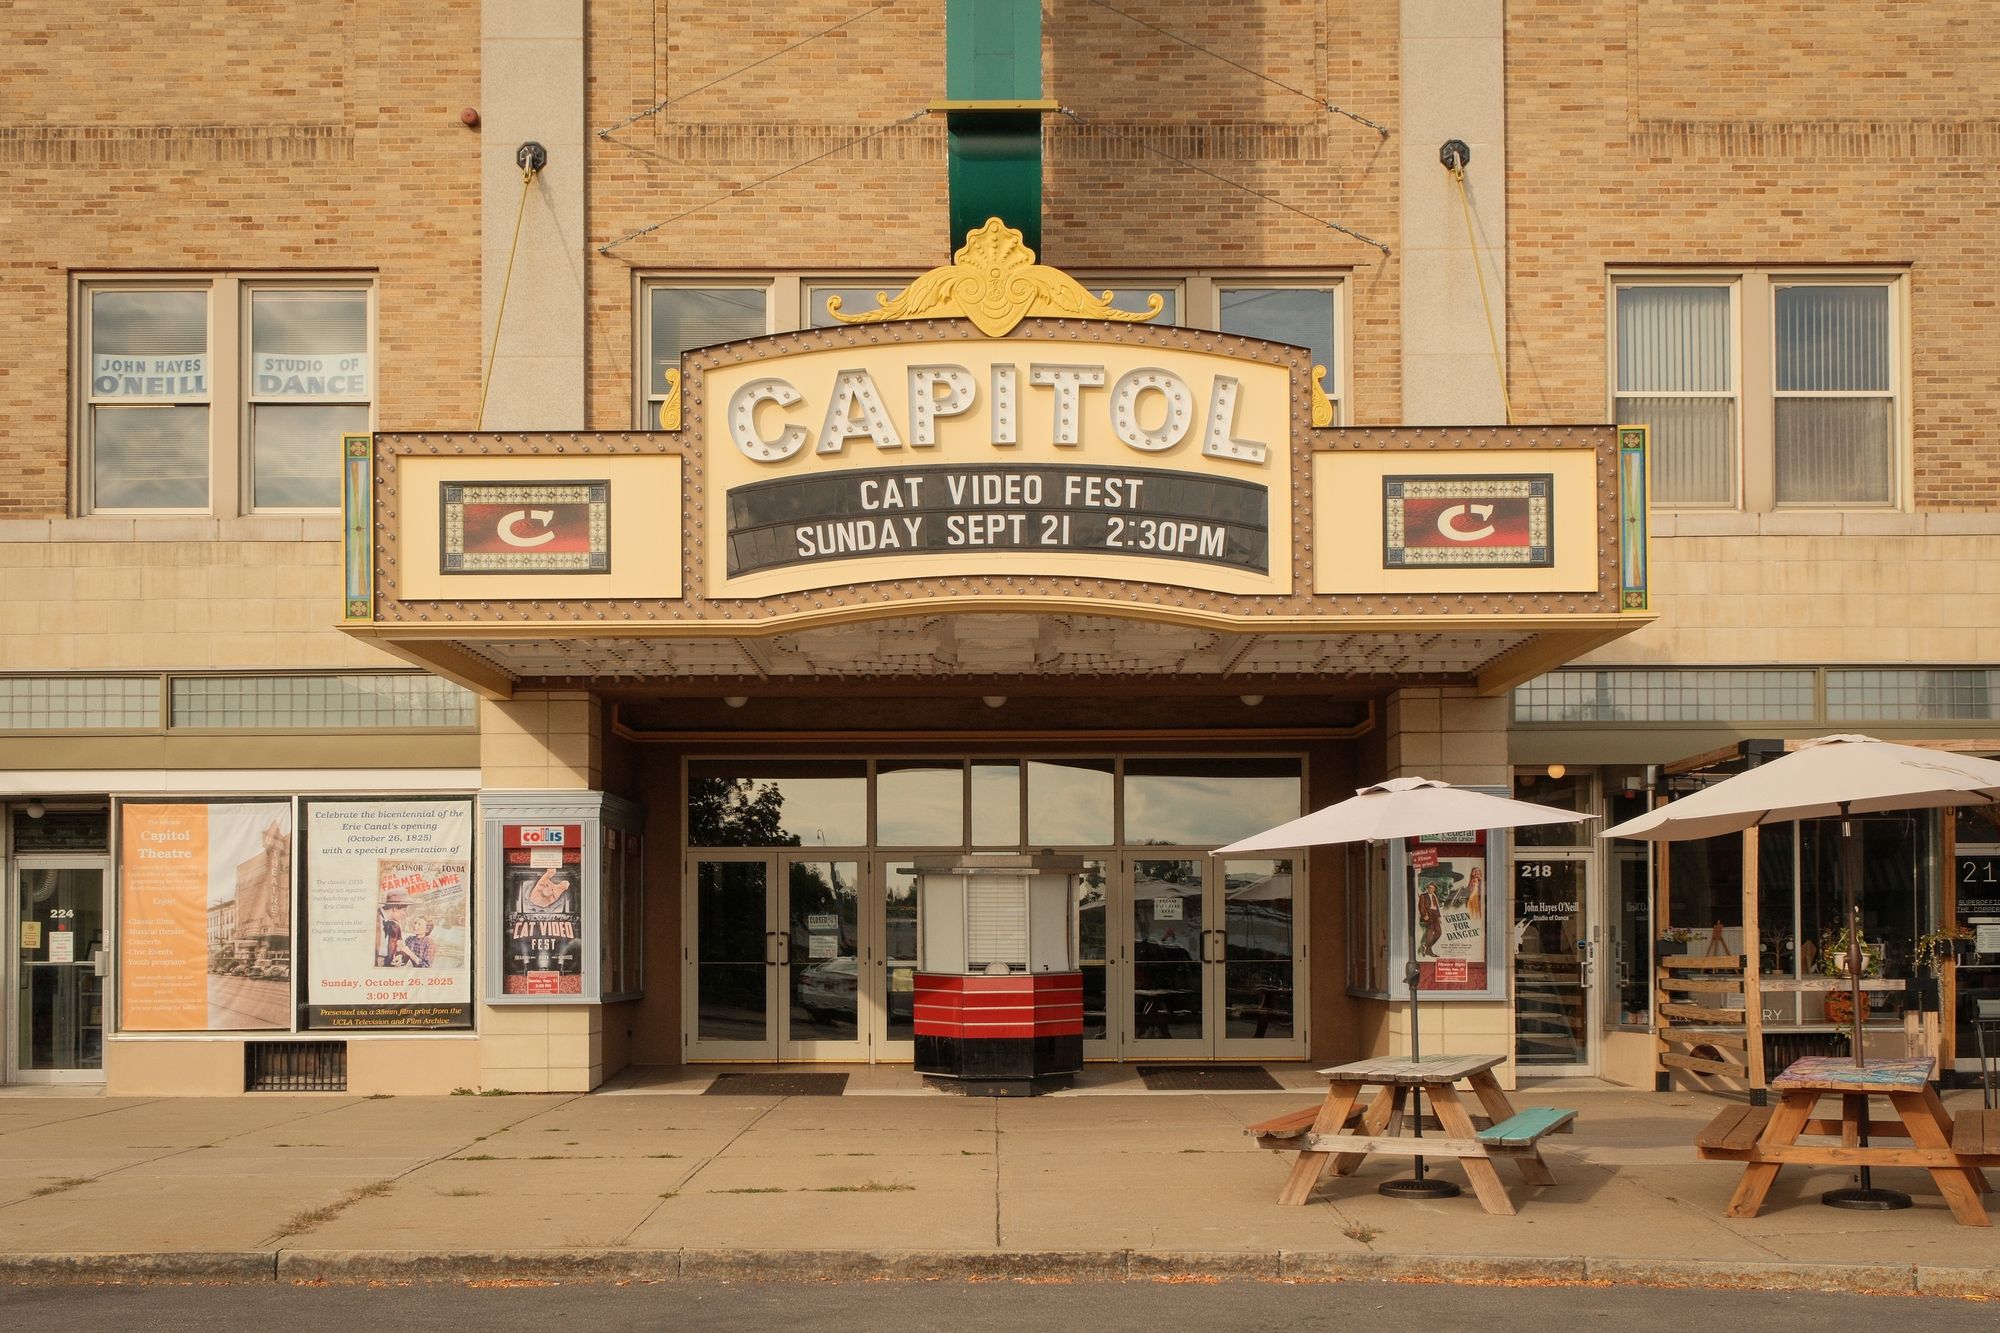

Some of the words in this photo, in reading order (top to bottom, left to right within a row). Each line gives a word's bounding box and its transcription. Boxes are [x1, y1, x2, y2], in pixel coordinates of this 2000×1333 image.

[101, 359, 147, 373] JOHN
[155, 359, 201, 372] HAYES
[265, 358, 323, 372] STUDIO
[340, 358, 360, 371] OF
[94, 373, 207, 395] O'NEILL
[259, 374, 365, 395] DANCE
[726, 362, 1271, 466] CAPITOL
[858, 476, 924, 511] CAT
[945, 474, 1043, 507] VIDEO
[1063, 477, 1144, 510] FEST
[795, 515, 925, 559] SUNDAY
[945, 514, 1026, 547] SEPT
[1038, 513, 1070, 546] 21
[1105, 517, 1227, 559] 2:30PM
[315, 811, 360, 819] Celebrate
[361, 811, 375, 819] the
[378, 810, 435, 818] bicentennial
[438, 810, 448, 819] of
[342, 823, 361, 831] Erie
[364, 822, 398, 831] Canal's
[401, 822, 438, 832] opening
[141, 830, 190, 843] Capitol
[347, 835, 384, 843] (October
[406, 835, 432, 843] 1825)
[138, 848, 192, 859] Theatre
[354, 846, 387, 856] special
[390, 846, 447, 856] presentation
[450, 845, 461, 855] of
[1521, 864, 1552, 878] 218
[381, 873, 424, 891] FARMER
[438, 873, 461, 888] WIFE
[50, 909, 75, 919] 224
[1523, 902, 1538, 915] John
[1539, 902, 1557, 914] Hayes
[1558, 902, 1580, 912] O'Neill
[513, 921, 536, 940] CAT
[539, 921, 575, 940] VIDEO
[1453, 921, 1470, 931] FOR
[531, 938, 556, 951] FEST
[321, 979, 363, 989] Sunday,
[365, 979, 405, 987] October
[427, 978, 454, 986] 2025
[366, 992, 390, 1000] 3:00
[393, 992, 409, 1000] PM
[375, 1008, 398, 1016] 35mm
[414, 1008, 431, 1017] print
[432, 1008, 449, 1017] from
[450, 1007, 462, 1015] the
[333, 1018, 353, 1026] UCLA
[355, 1018, 390, 1026] Television
[391, 1017, 404, 1026] and
[406, 1017, 422, 1026] Film
[423, 1017, 450, 1026] Archive
